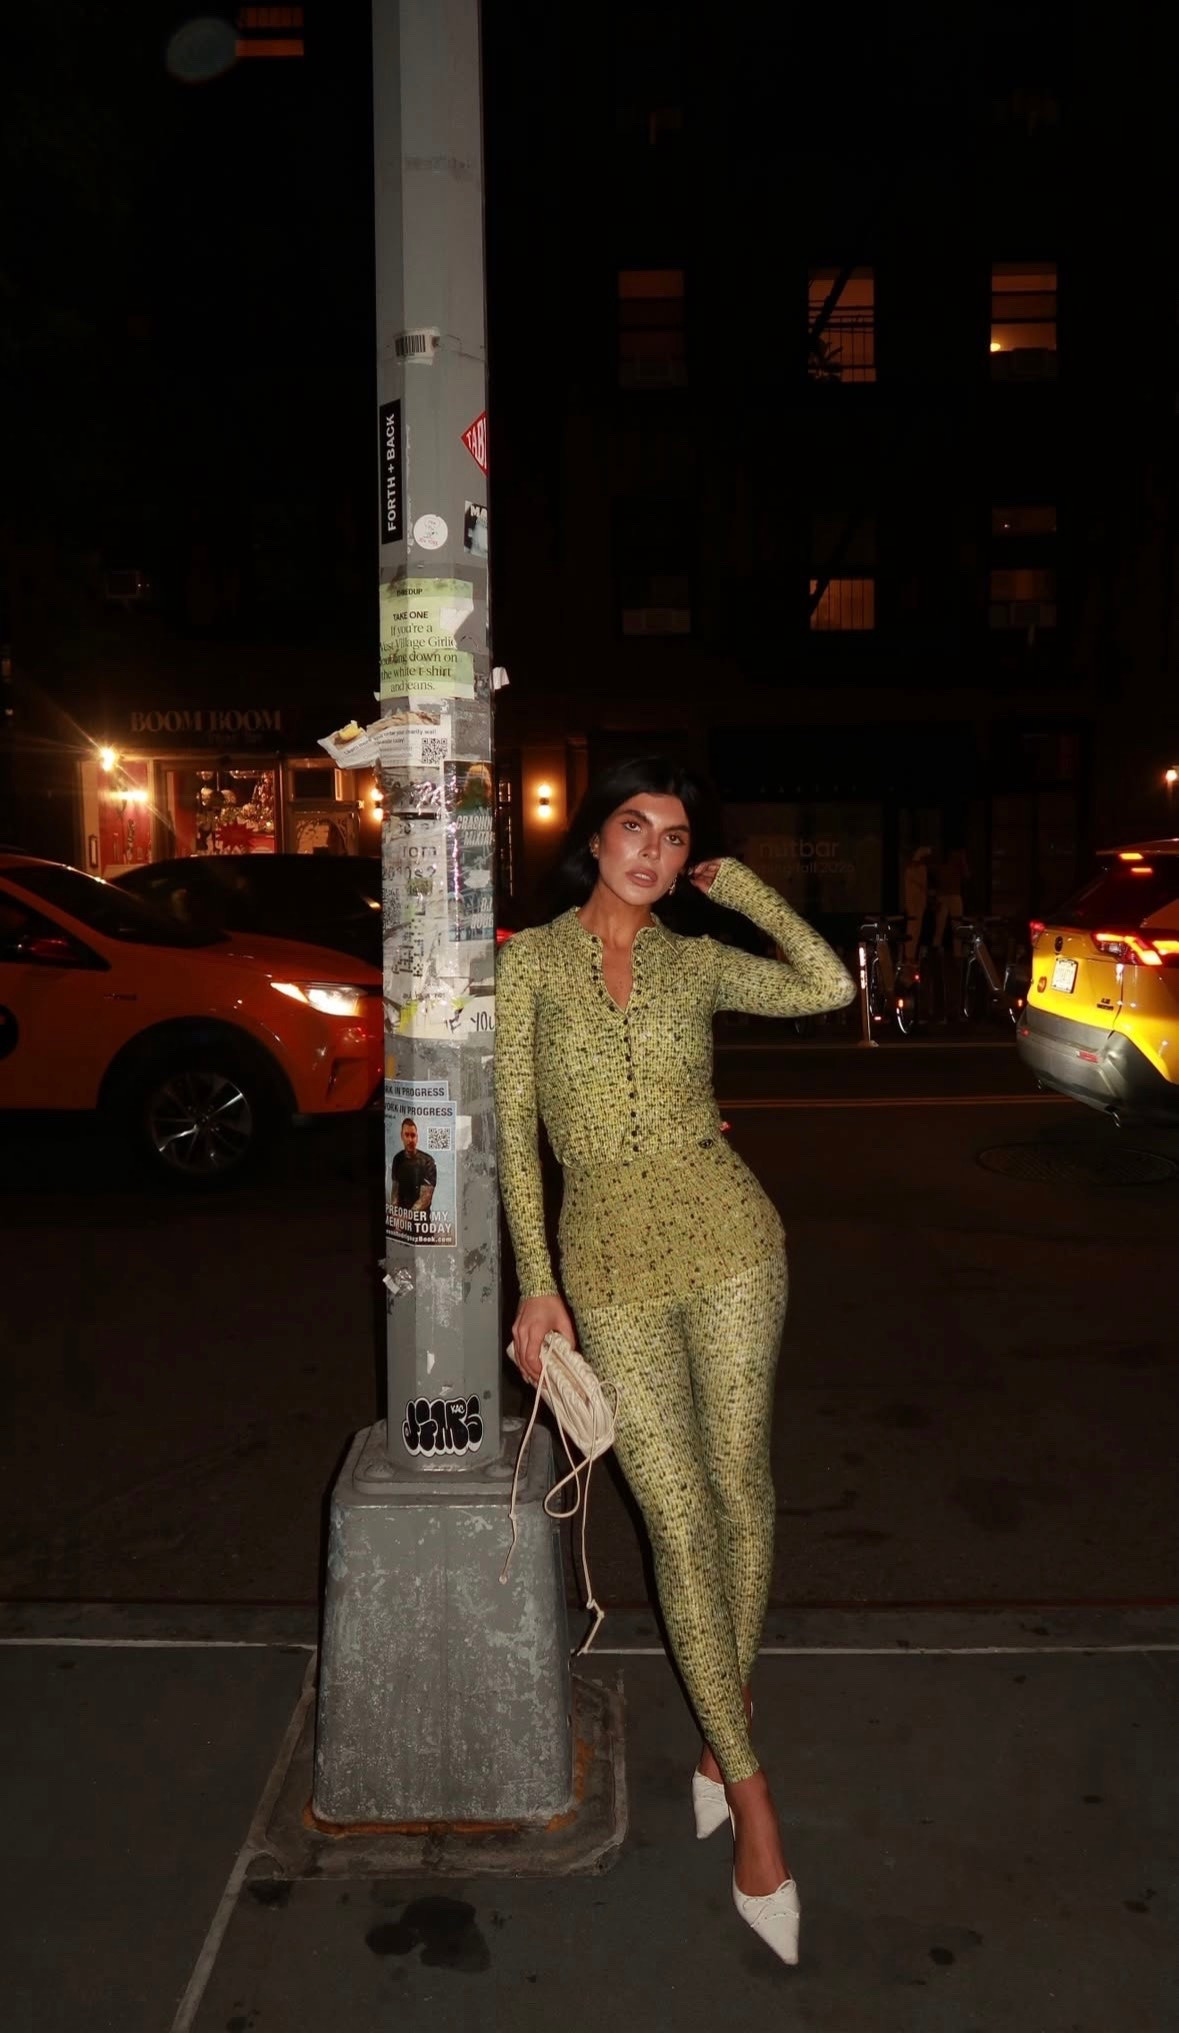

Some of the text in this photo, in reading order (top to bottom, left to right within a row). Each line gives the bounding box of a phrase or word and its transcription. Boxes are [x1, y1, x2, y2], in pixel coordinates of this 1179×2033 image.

[386, 413, 395, 461] BACK
[387, 476, 397, 531] FORTH
[393, 611, 429, 621] TAKE ONE
[391, 623, 433, 636] If you're a
[395, 637, 425, 650] Village
[408, 650, 441, 661] down
[443, 653, 458, 663] on
[394, 666, 417, 677] white
[418, 665, 451, 677] t-shirt
[390, 680, 436, 692] and jeans.
[130, 710, 281, 732] BOOM BOOM
[759, 839, 841, 858] nutbar
[394, 1086, 401, 1096] IN
[402, 1086, 445, 1098] PROGRESS
[399, 1104, 407, 1115] IN
[407, 1105, 453, 1117] PROGRESS
[385, 1203, 449, 1221] PREORDER MY
[414, 1222, 451, 1234] TODAY
